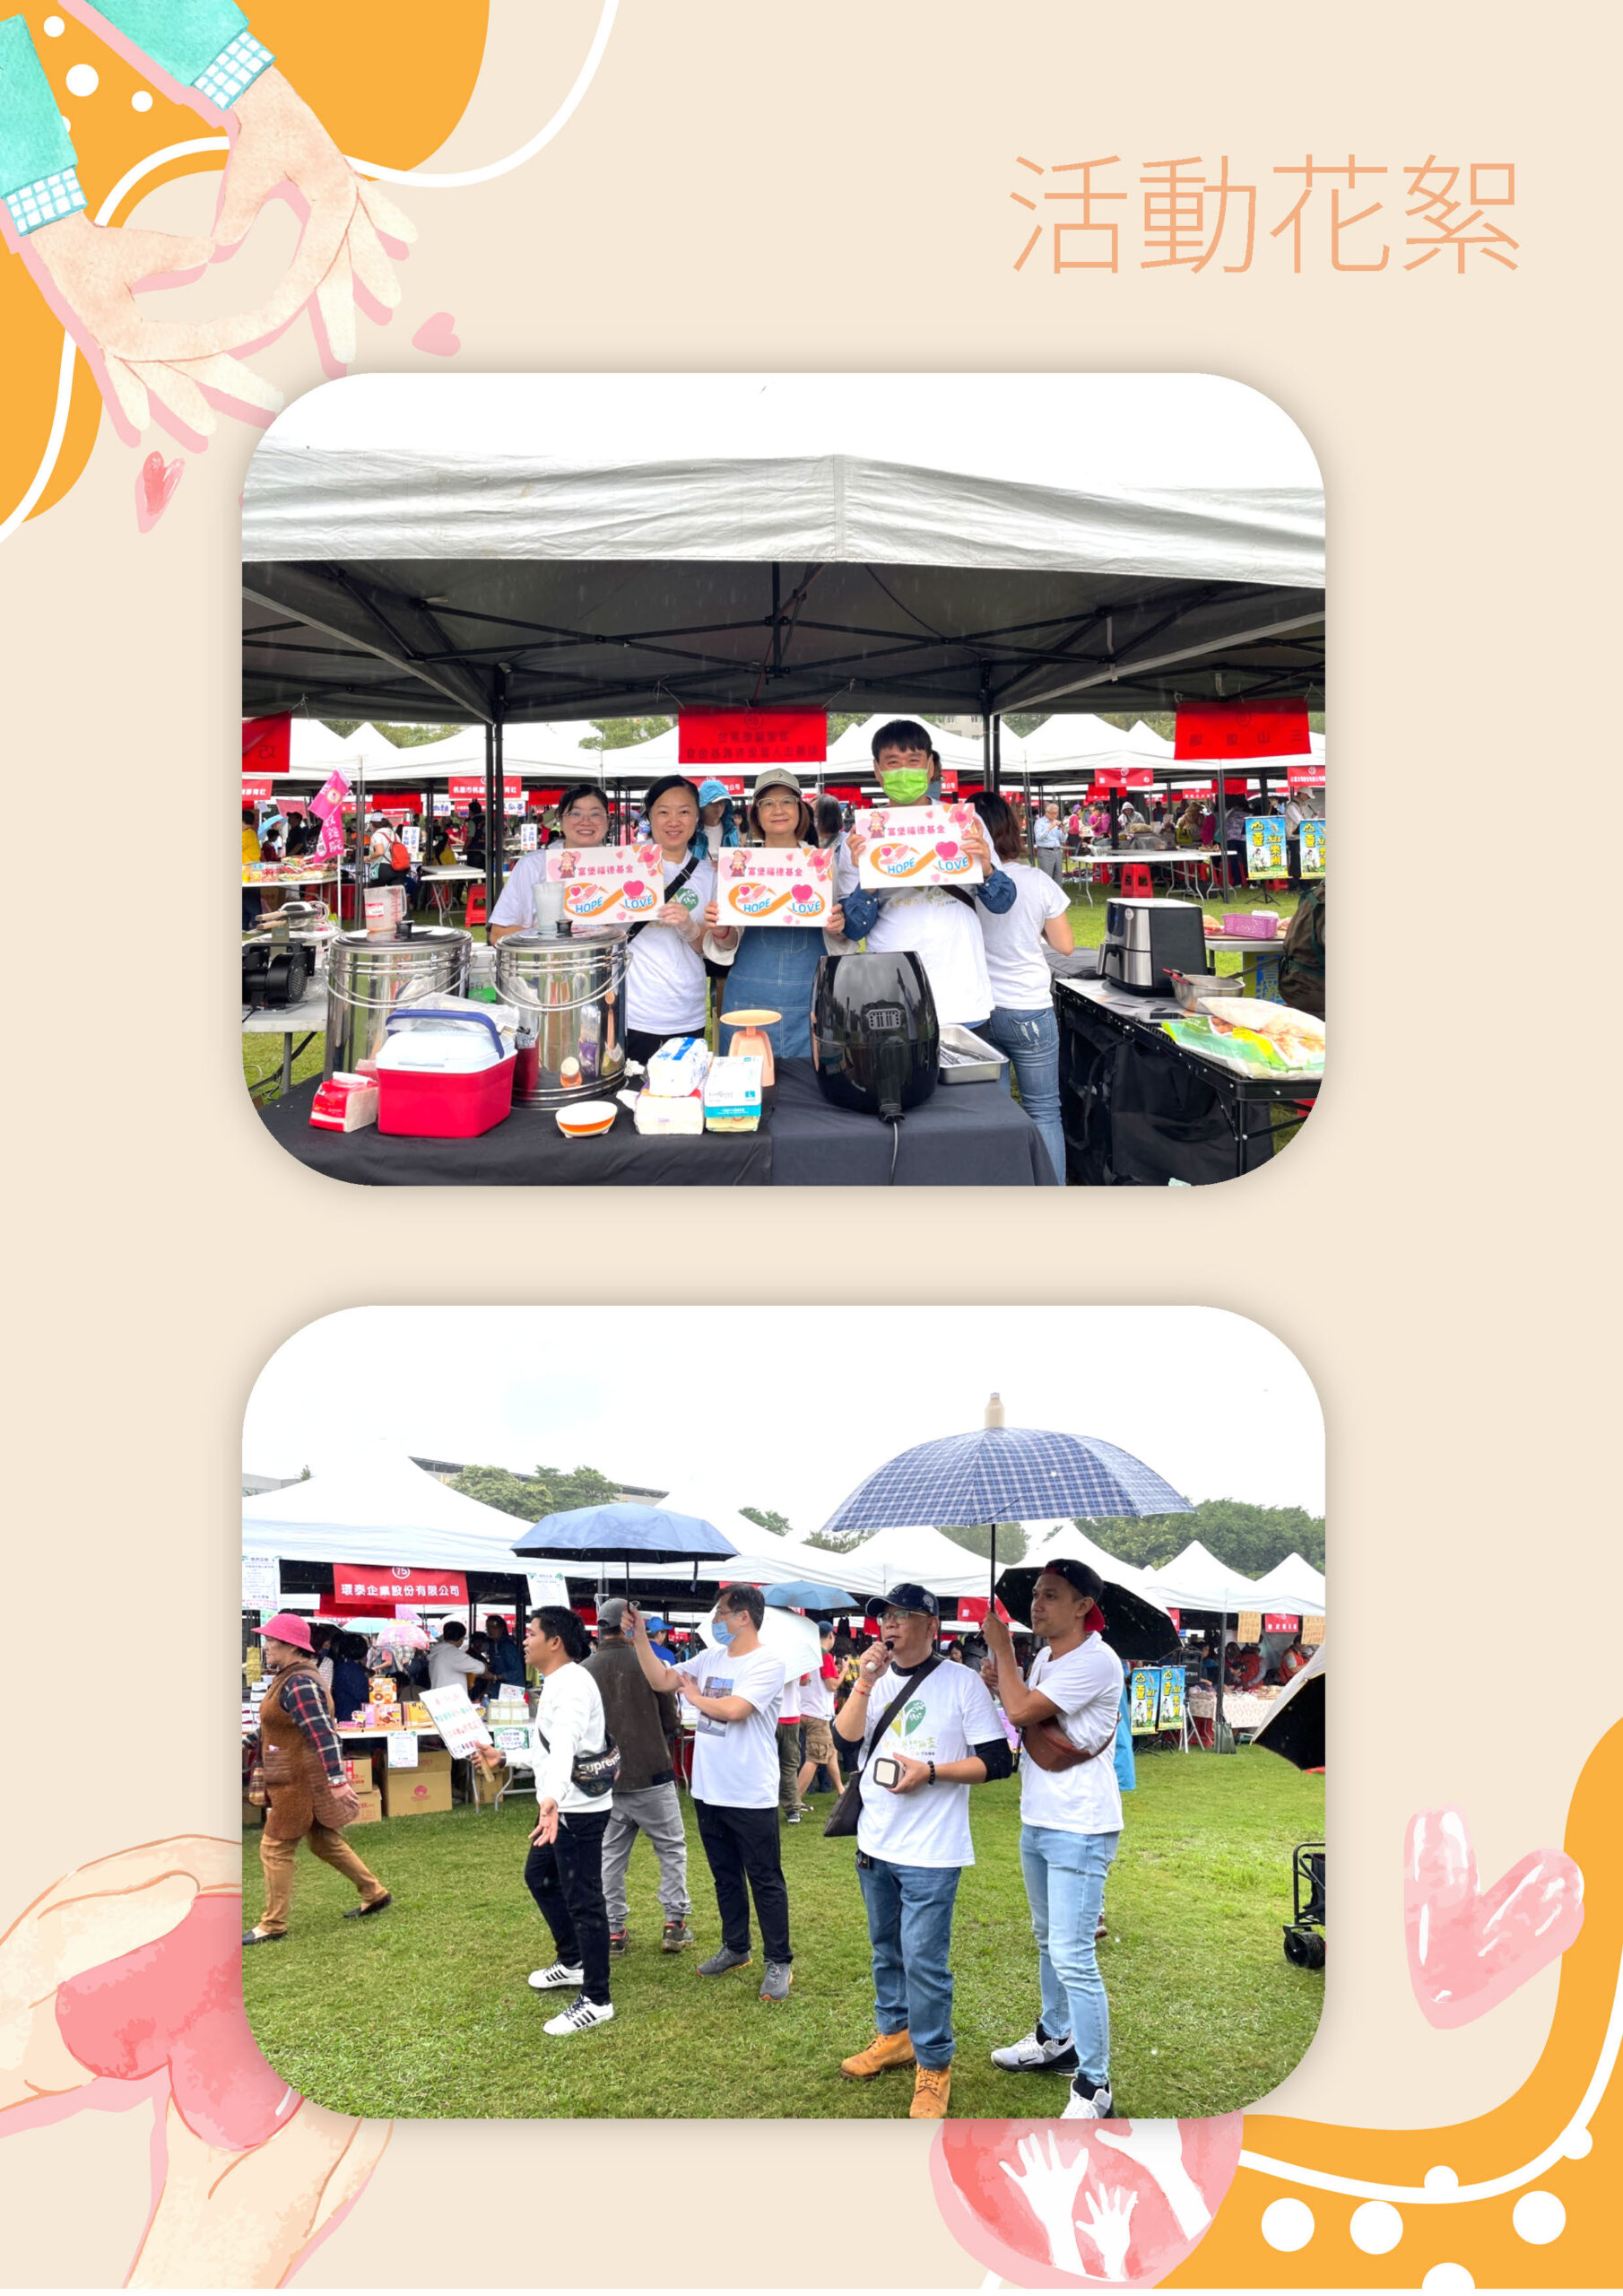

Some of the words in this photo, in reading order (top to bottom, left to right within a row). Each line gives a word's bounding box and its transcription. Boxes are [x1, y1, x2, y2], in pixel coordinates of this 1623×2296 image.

[888, 825, 946, 836] 富堡福德基金
[577, 865, 634, 876] 富堡福德基金
[887, 857, 916, 874] HOPE
[938, 857, 969, 871] LOVE
[748, 867, 803, 876] 富堡福德基金
[576, 897, 603, 913] HOPE
[624, 895, 654, 909] LOVE
[743, 898, 771, 913] HOPE
[792, 900, 821, 913] LOVE
[395, 1566, 407, 1576] 75
[341, 1584, 460, 1596] 環泰企業股份有限公司
